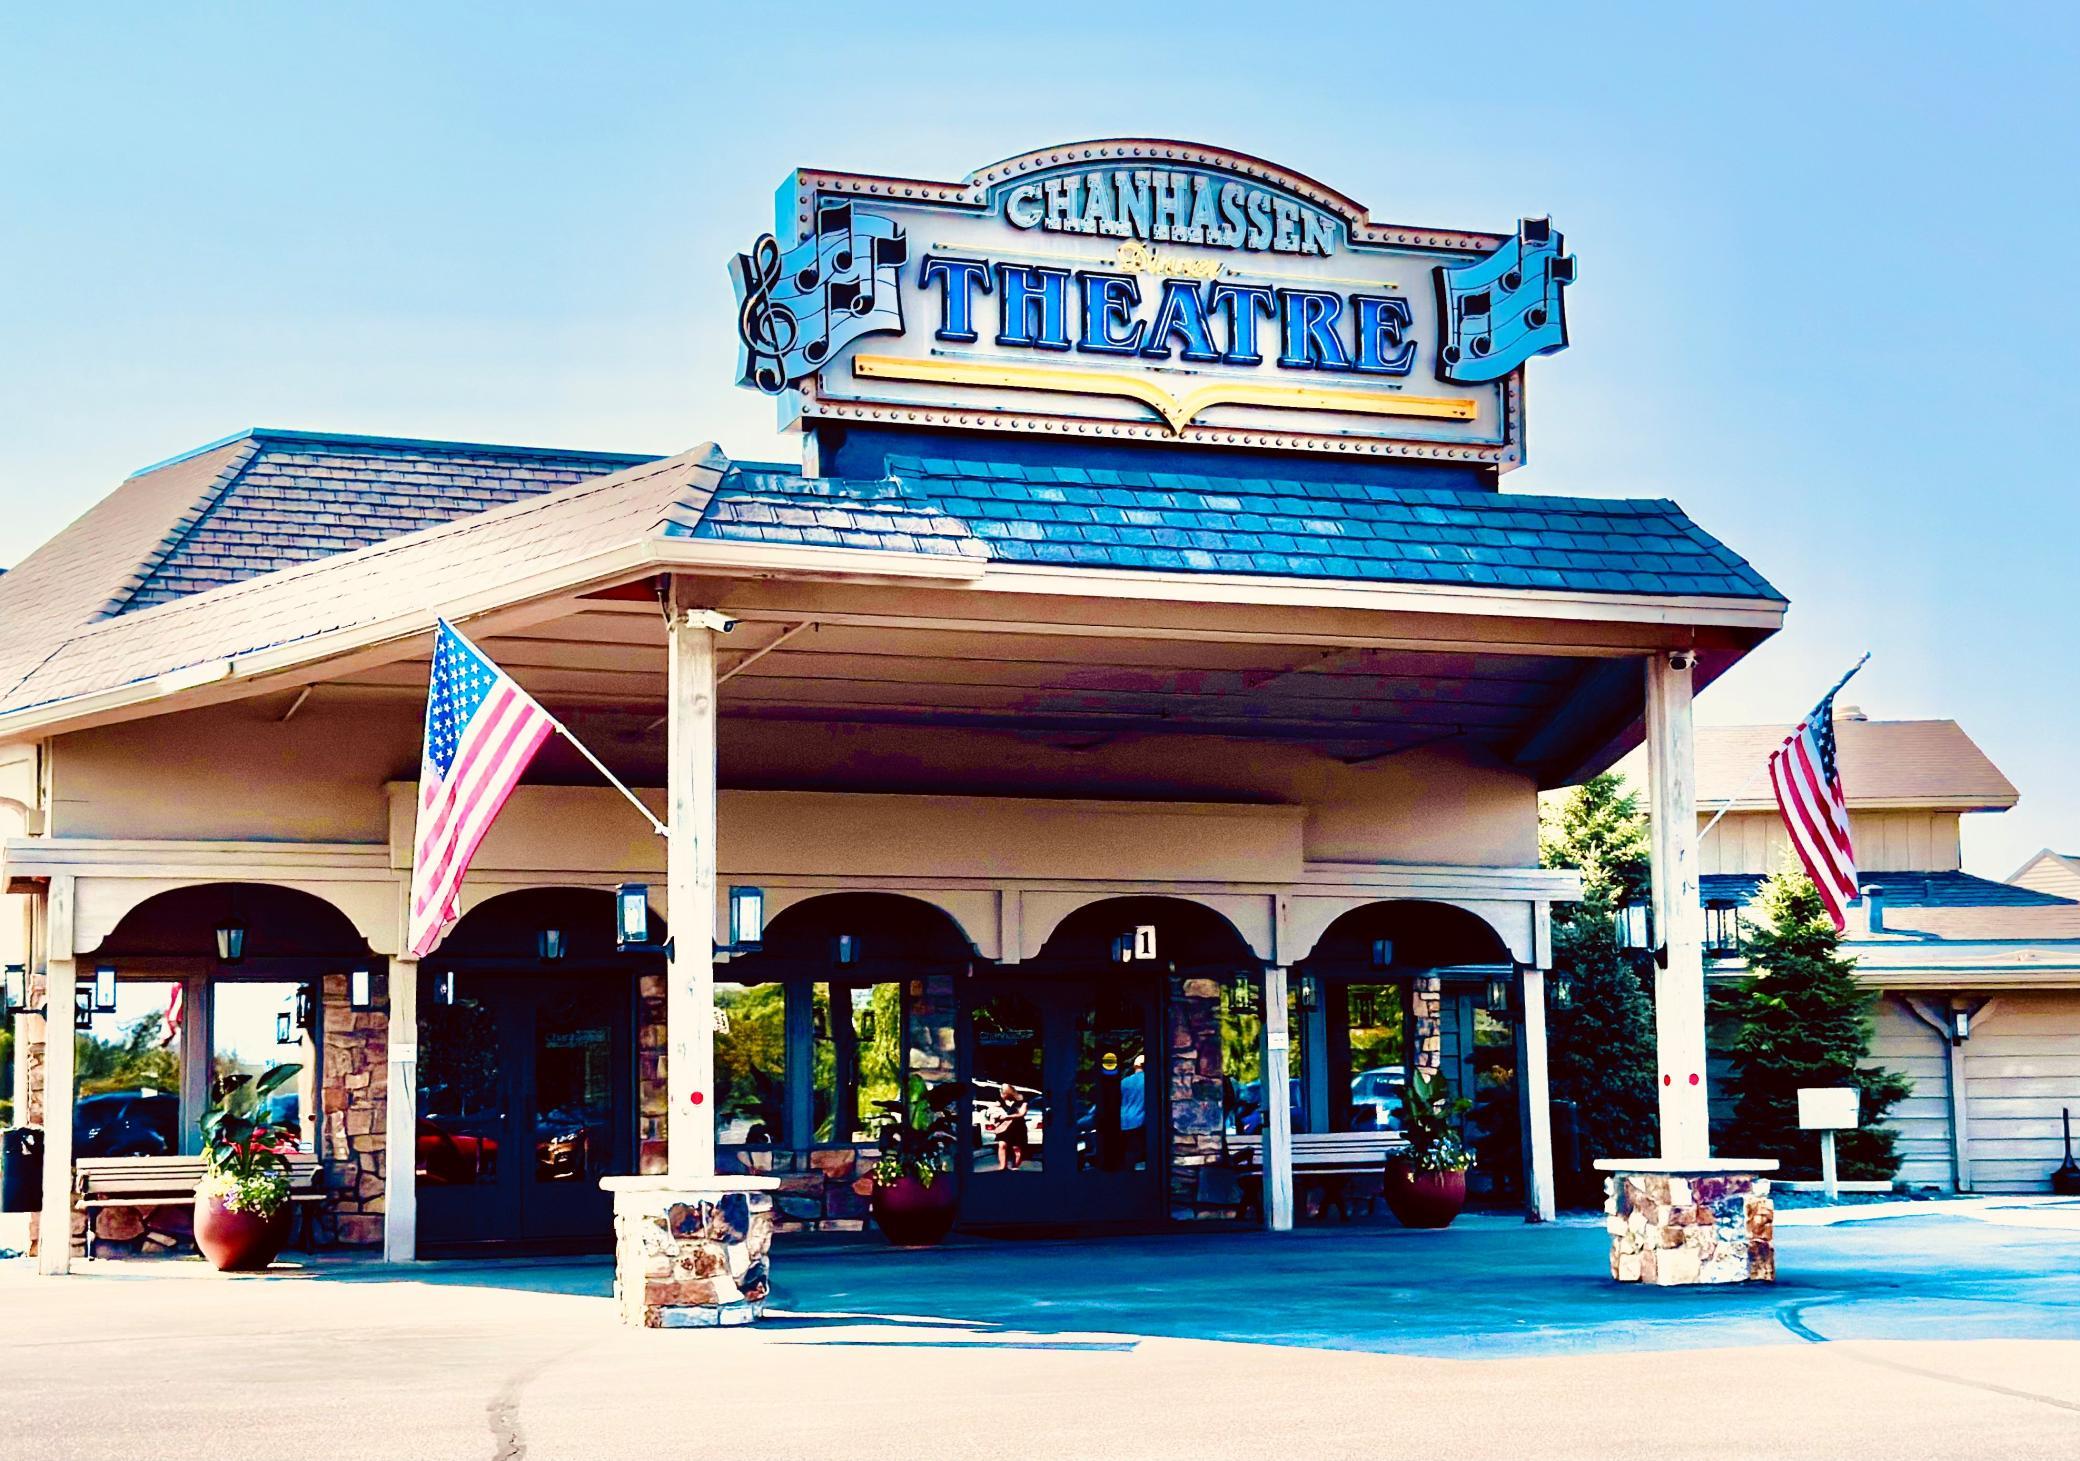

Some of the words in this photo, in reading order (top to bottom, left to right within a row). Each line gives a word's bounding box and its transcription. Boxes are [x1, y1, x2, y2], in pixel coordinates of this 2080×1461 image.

[1006, 171, 1336, 256] CHANHASSEN
[918, 254, 1418, 376] THEATRE
[1140, 931, 1150, 953] 1
